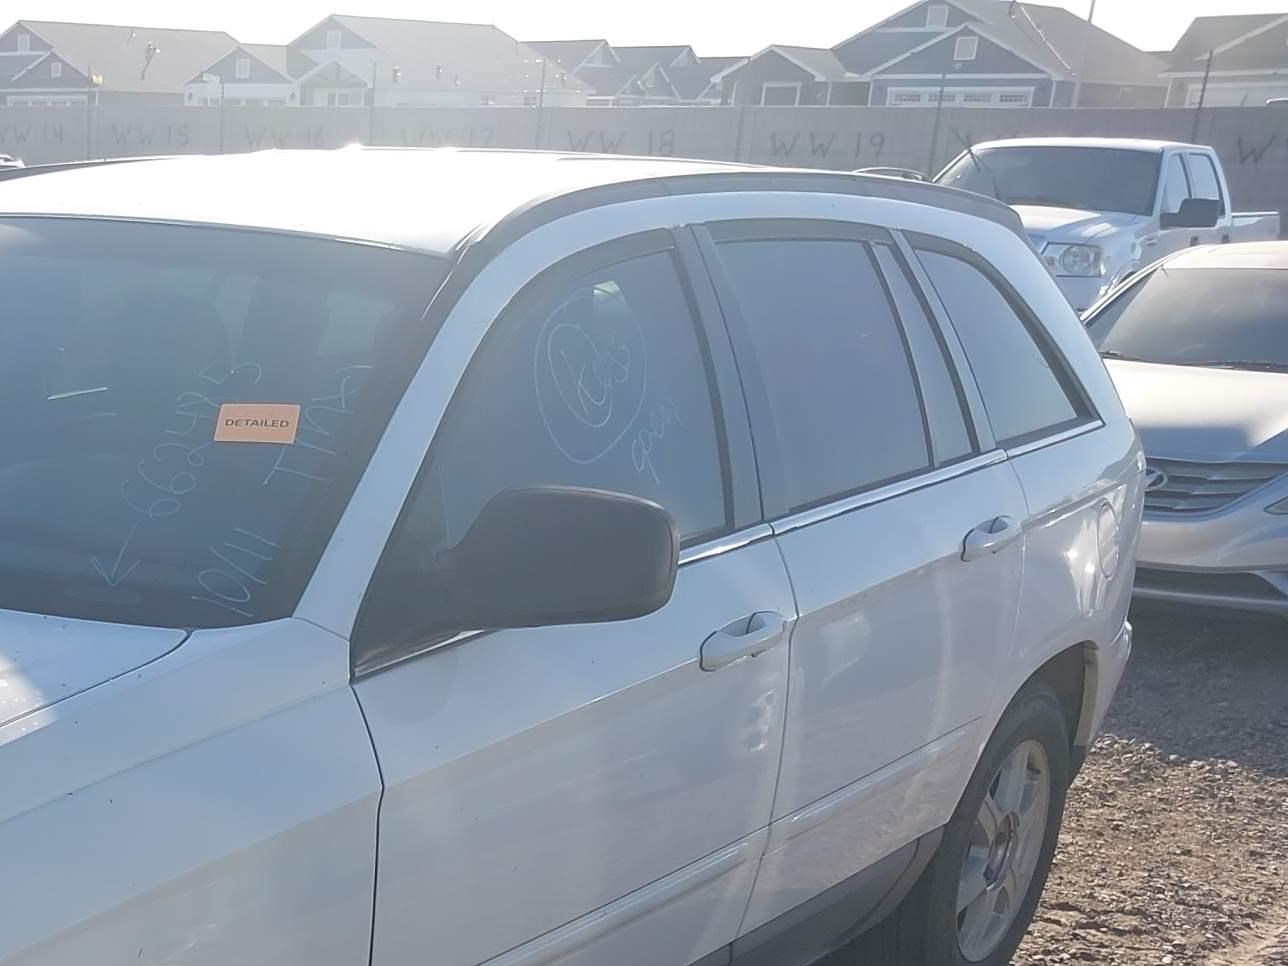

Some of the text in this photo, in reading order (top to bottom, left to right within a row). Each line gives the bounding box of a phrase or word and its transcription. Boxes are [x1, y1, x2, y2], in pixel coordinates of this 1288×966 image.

[42, 121, 64, 145] 14
[167, 122, 191, 147] 15
[648, 128, 676, 157] 18
[855, 131, 887, 159] 19
[224, 417, 290, 429] DETAILED
